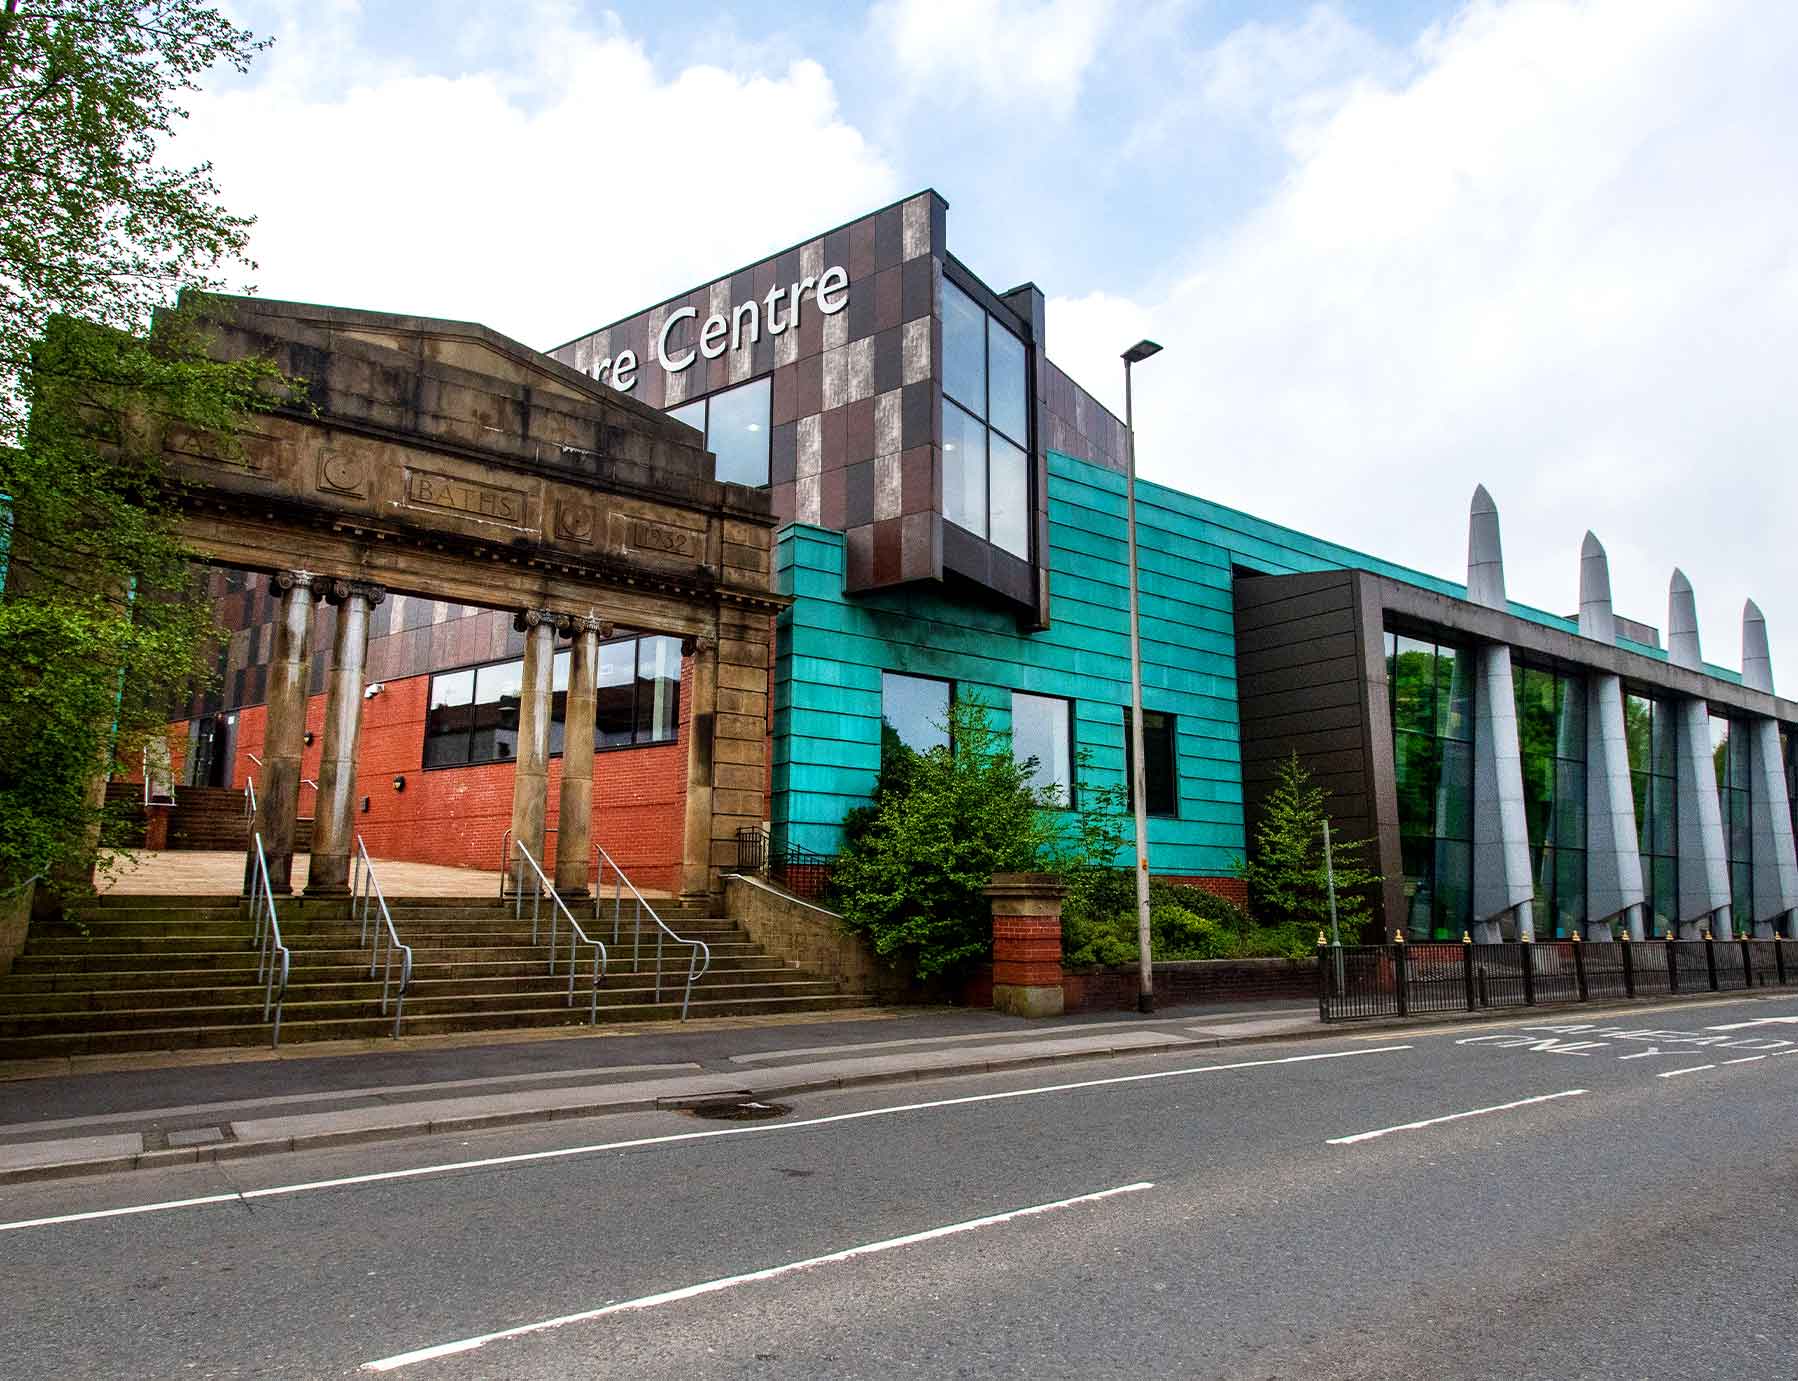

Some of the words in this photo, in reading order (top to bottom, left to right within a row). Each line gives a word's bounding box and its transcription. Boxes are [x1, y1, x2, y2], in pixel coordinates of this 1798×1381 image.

[658, 265, 848, 372] Centre
[418, 478, 512, 517] BATHS
[644, 525, 688, 552] 1932
